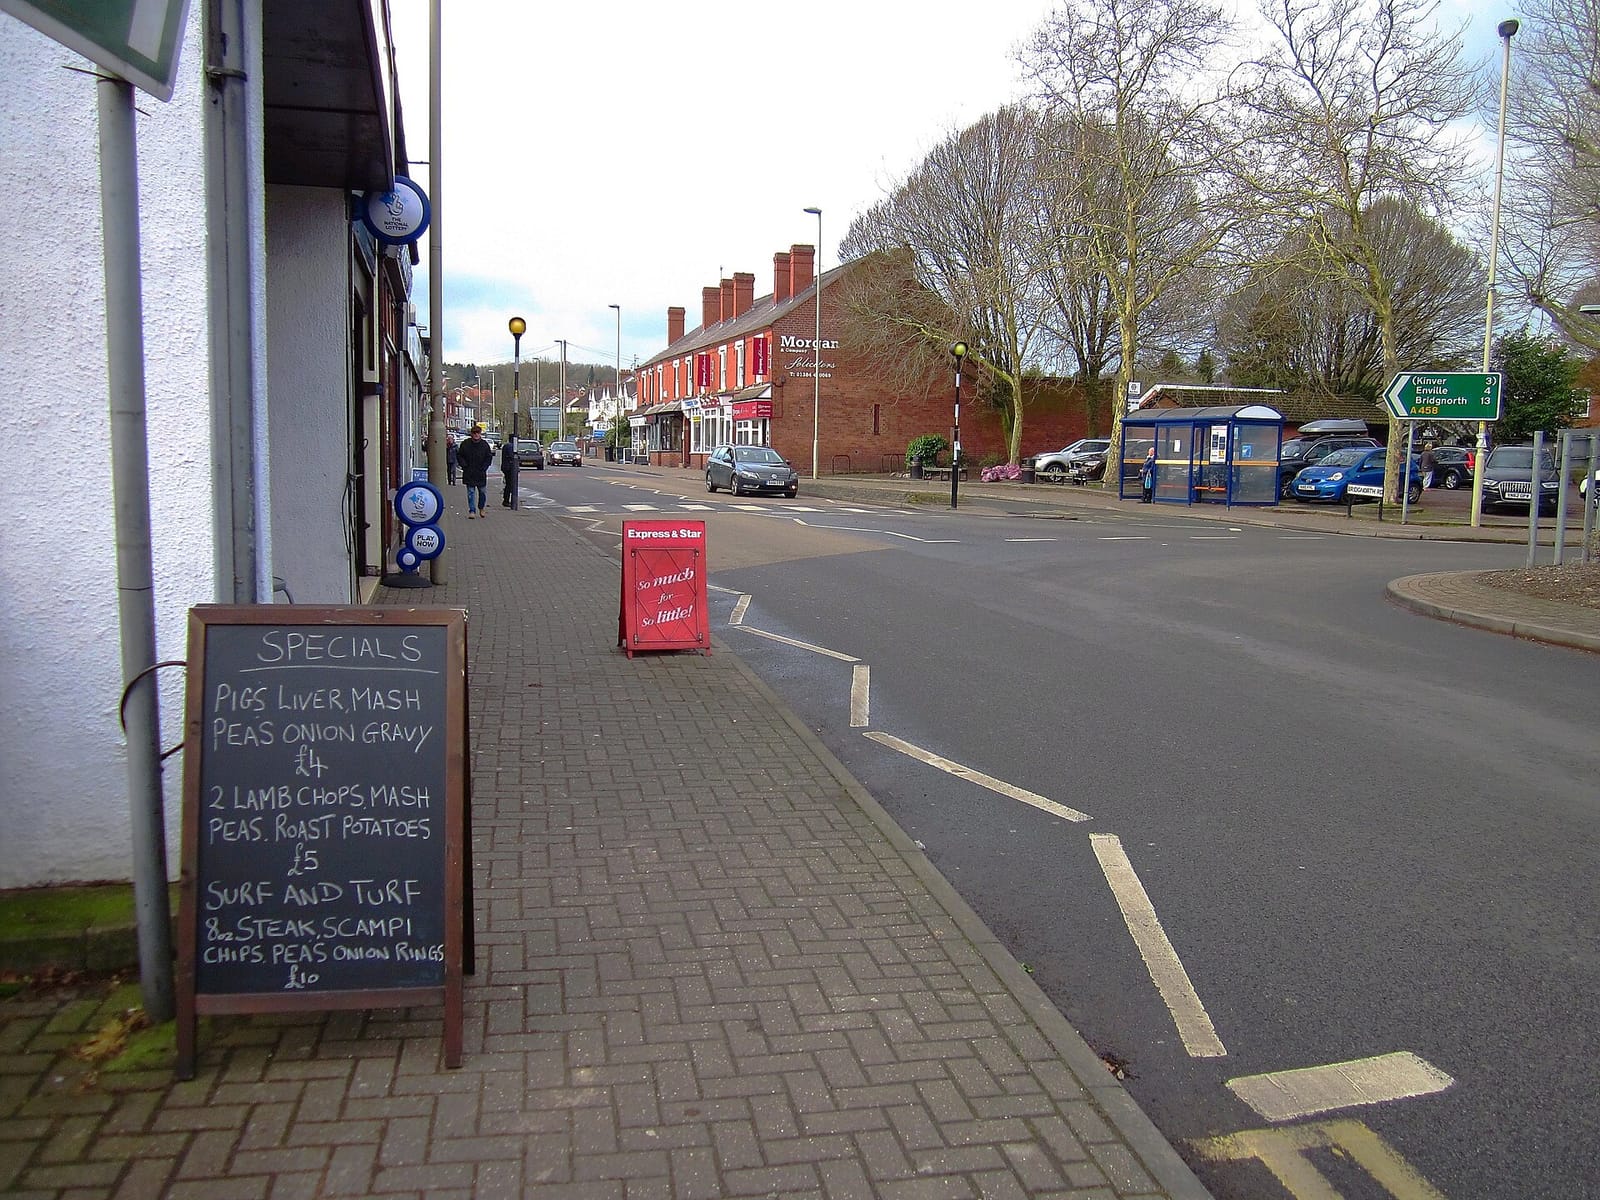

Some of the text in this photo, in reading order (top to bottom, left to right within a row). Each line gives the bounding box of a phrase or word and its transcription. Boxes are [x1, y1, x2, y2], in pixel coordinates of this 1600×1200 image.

[781, 336, 839, 350] Morgan
[1412, 376, 1447, 386] (Kinver
[1416, 386, 1448, 394] Enville
[1416, 396, 1467, 405] Bridgnorth
[628, 529, 702, 539] Express & Star
[654, 568, 694, 587] much
[658, 593, 673, 604] for
[657, 605, 693, 623] little!
[257, 631, 421, 662] SPECIALS
[352, 687, 421, 712] MASH
[283, 723, 355, 745] ONION
[362, 722, 433, 752] GRAVY
[295, 744, 328, 778] £4
[208, 785, 224, 809] 2
[234, 785, 292, 810] LAMB
[371, 786, 429, 809] MASH
[287, 842, 319, 876] £5
[206, 879, 421, 910] SURF AND TURF
[323, 917, 411, 938] SCAMPI
[333, 945, 389, 960] ONION
[395, 942, 444, 962] RINGS
[284, 964, 320, 988] £10
